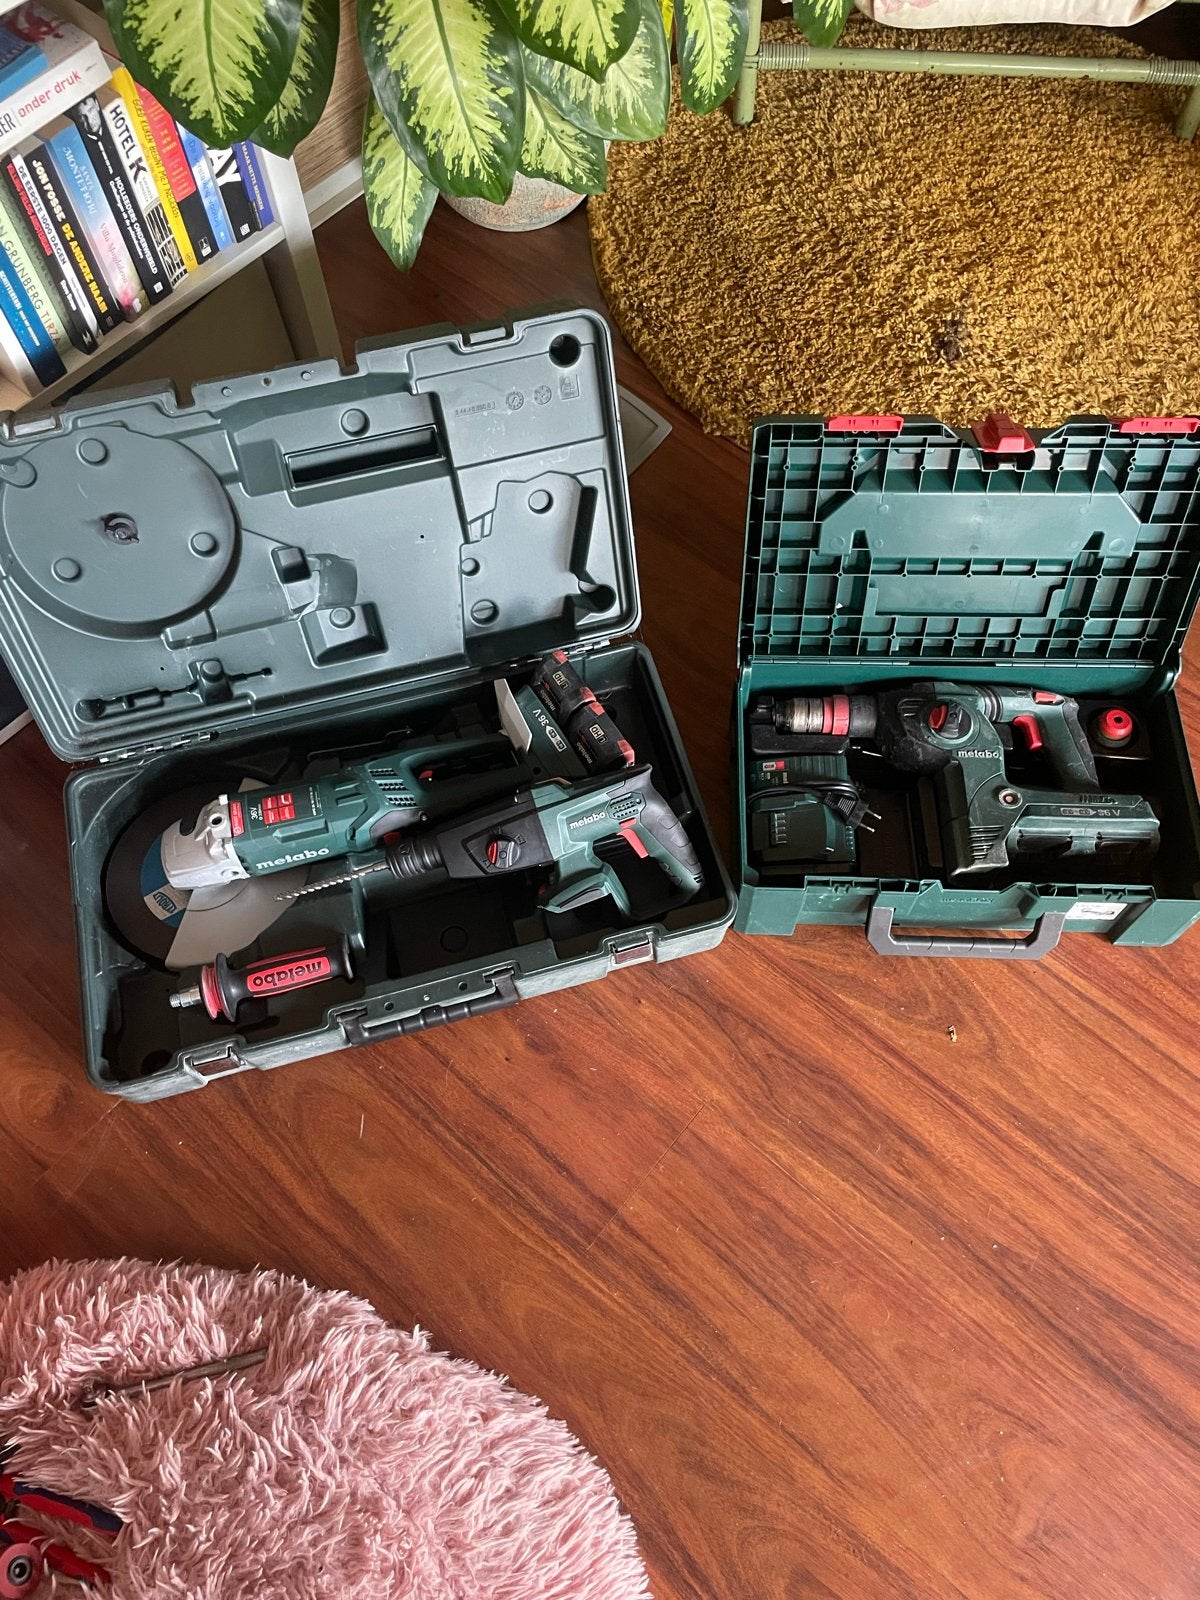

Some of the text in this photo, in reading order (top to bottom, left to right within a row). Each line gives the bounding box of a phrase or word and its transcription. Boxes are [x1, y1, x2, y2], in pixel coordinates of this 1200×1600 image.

[17, 89, 51, 118] onder
[54, 70, 81, 94] druk
[110, 105, 147, 184] HOTEL K
[80, 165, 95, 190] SANTA
[242, 144, 252, 165] MAAR
[247, 165, 259, 185] NETTE
[254, 185, 265, 211] MENSEN
[18, 165, 67, 265] DE EERSTE 1000 DAGEN
[115, 176, 158, 274] HOLLEEDERS ONDERWERELD
[32, 160, 49, 185] JON
[43, 182, 66, 222] FOSSE
[62, 223, 75, 240] DE
[69, 240, 94, 283] ANDERE
[88, 281, 108, 313] NAAM
[100, 222, 110, 242] Villa
[4, 240, 61, 345] GRUNBERG TIRZA
[532, 708, 550, 726] 36 V
[957, 749, 1000, 759] metabo
[569, 811, 606, 830] metabo
[1111, 809, 1121, 817] V
[256, 847, 330, 870] metabo
[253, 960, 323, 988] metabo
